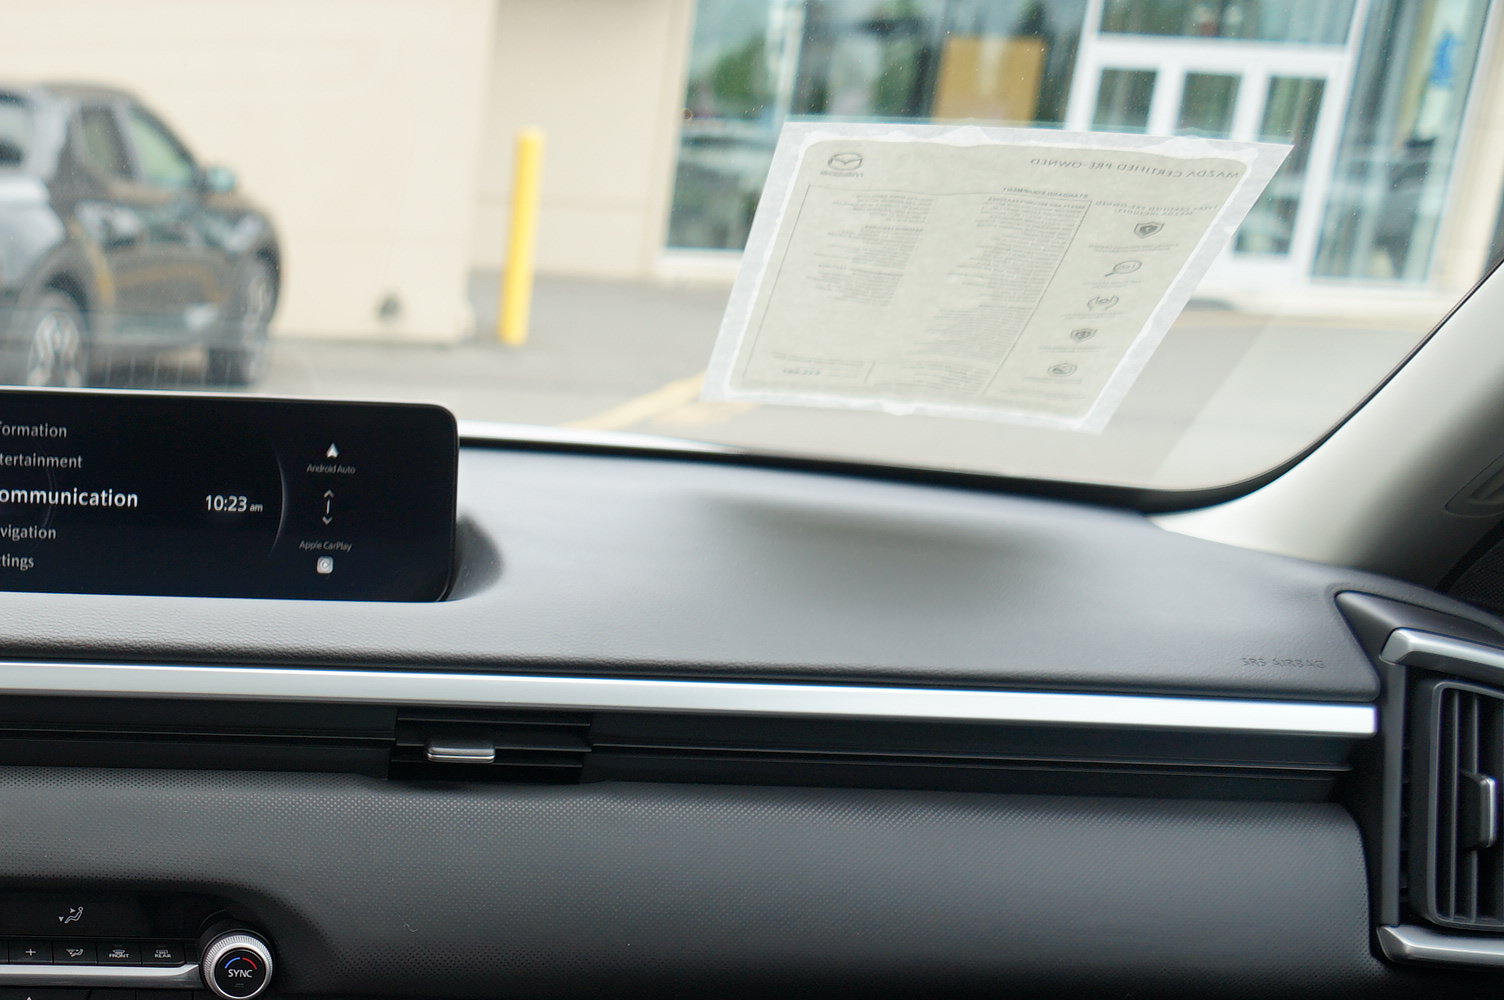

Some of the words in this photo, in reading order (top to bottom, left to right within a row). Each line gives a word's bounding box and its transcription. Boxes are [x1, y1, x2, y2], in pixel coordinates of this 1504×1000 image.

[307, 464, 336, 473] Android
[337, 465, 356, 474] Auto
[205, 495, 247, 512] 10:23
[250, 502, 263, 512] am
[299, 540, 322, 551] Apple
[323, 541, 352, 552] CarPlay
[1240, 656, 1266, 667] SRS
[1271, 658, 1327, 669] AIRBAG
[109, 952, 130, 960] FRONT
[228, 969, 253, 978] SYNC
